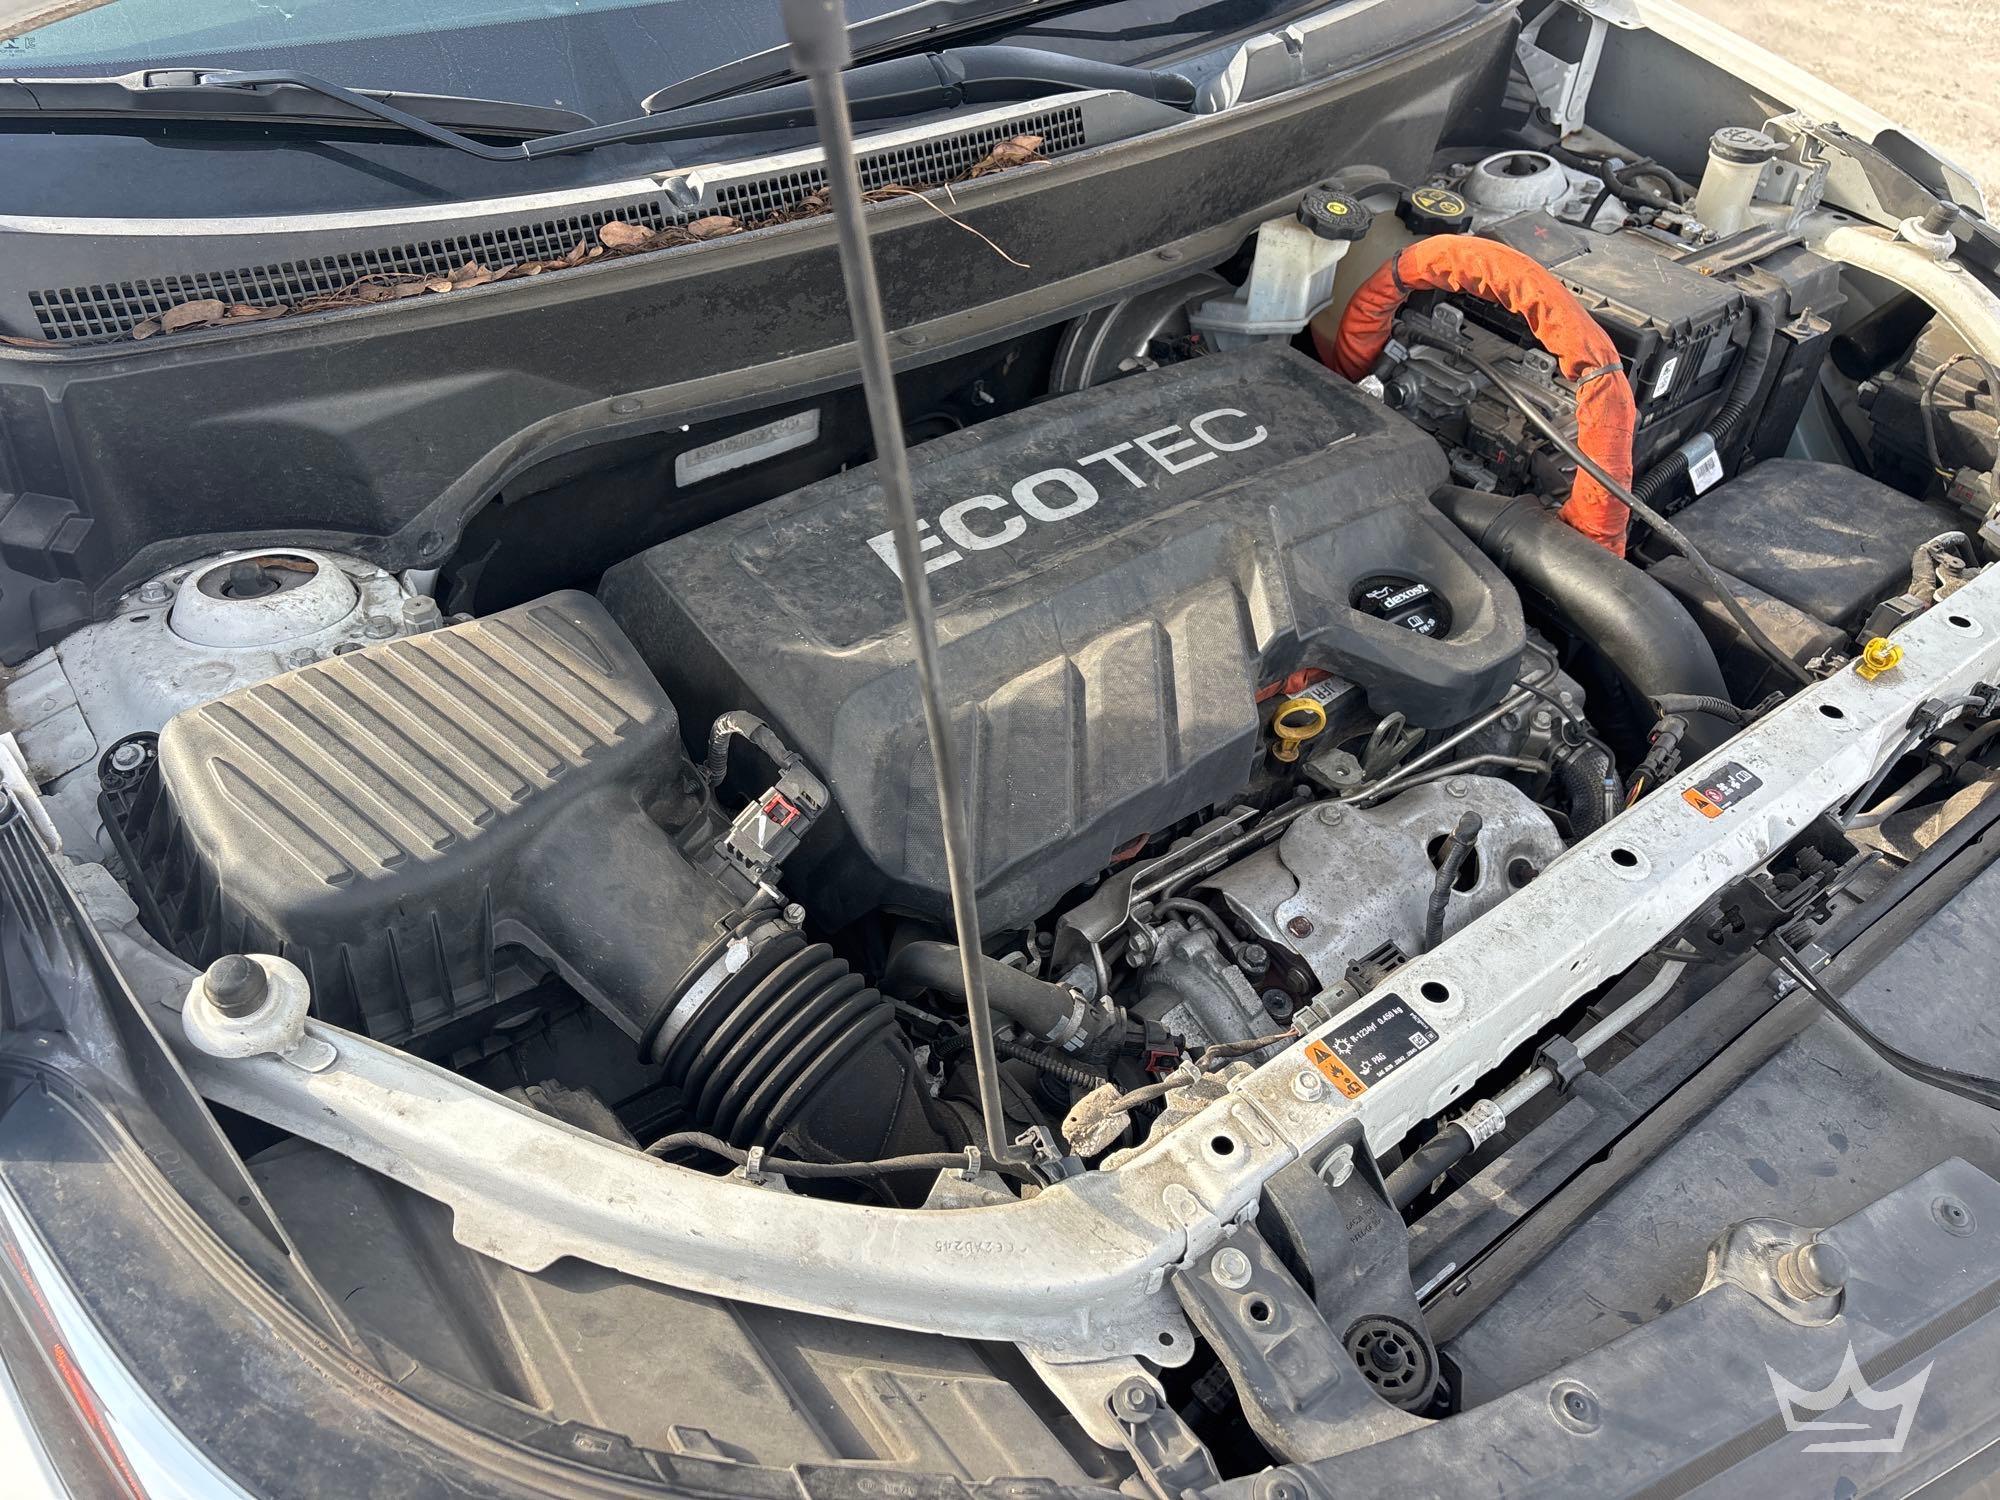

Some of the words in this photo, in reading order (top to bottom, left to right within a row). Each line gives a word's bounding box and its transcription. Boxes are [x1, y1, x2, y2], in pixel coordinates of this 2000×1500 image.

[866, 408, 1268, 583] ECOTEC
[1384, 584, 1429, 608] dexos2
[1312, 682, 1336, 700] JFR
[1350, 1022, 1378, 1043] R-1234yf
[1377, 1010, 1394, 1025] 0.450
[1393, 1006, 1404, 1017] kg
[1371, 1052, 1387, 1065] PAG
